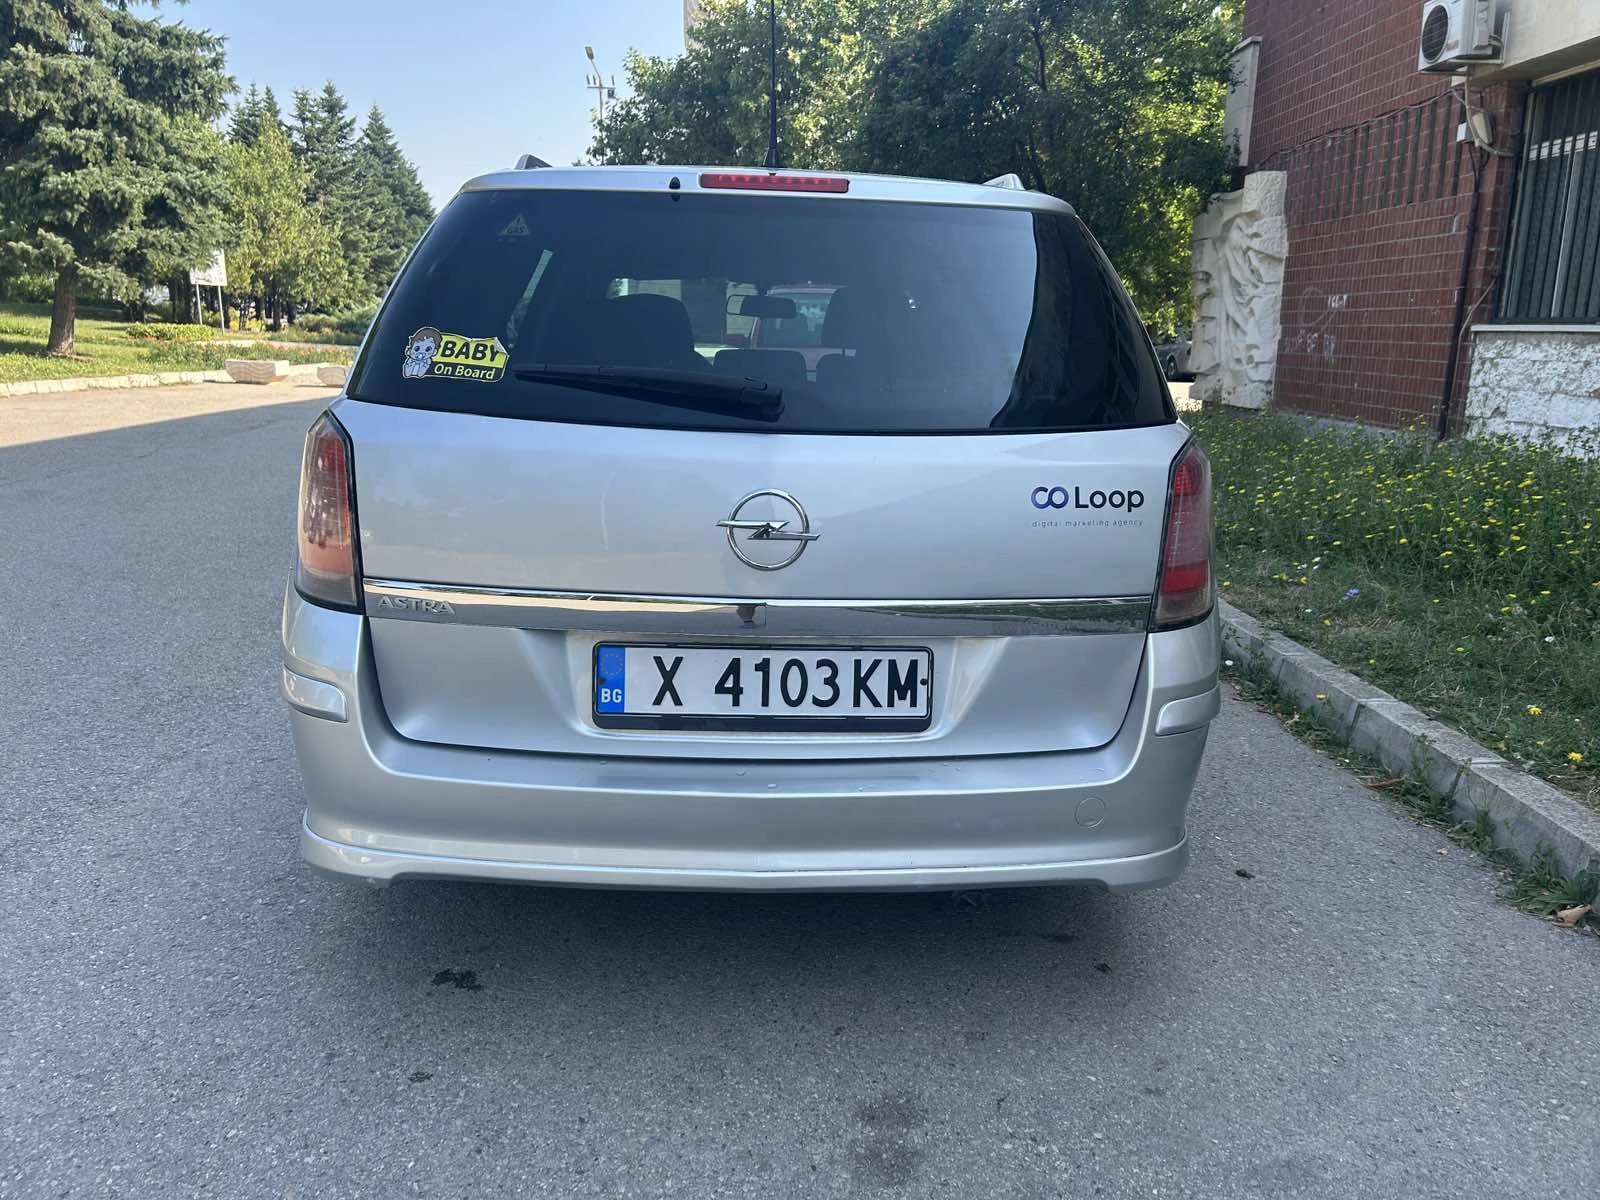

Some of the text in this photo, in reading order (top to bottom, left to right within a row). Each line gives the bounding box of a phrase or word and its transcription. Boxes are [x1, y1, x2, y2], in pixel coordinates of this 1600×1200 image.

[441, 340, 498, 362] BABY
[434, 363, 496, 380] On Board
[1074, 486, 1145, 513] Loop
[1065, 519, 1109, 528] marketing
[1113, 519, 1143, 528] agency
[377, 595, 456, 616] ASTRA
[652, 656, 685, 707] X
[600, 687, 623, 704] BG
